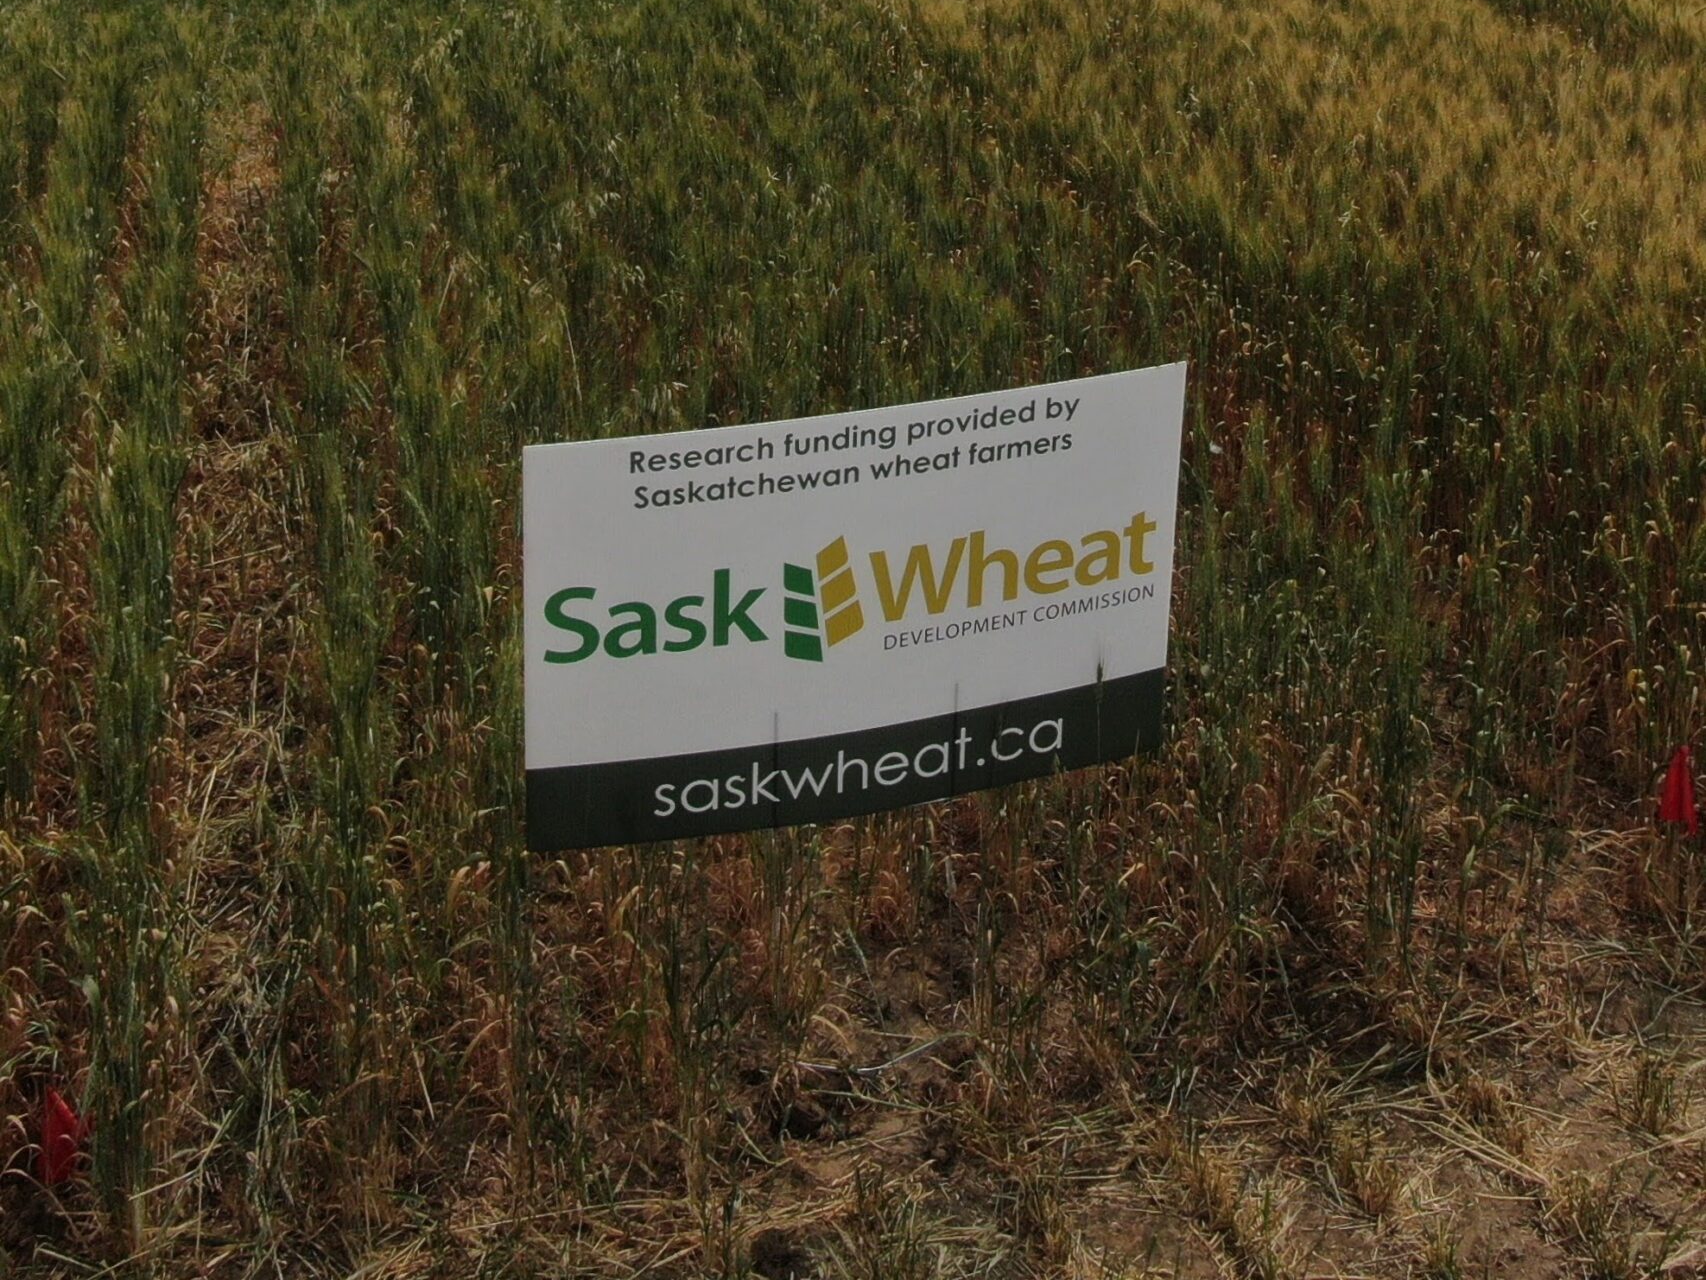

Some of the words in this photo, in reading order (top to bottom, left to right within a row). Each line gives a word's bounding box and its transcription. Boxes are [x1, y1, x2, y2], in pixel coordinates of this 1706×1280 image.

[629, 437, 775, 474] Research
[783, 423, 897, 457] funding
[907, 399, 1036, 446] provided
[1045, 397, 1081, 422] by
[633, 466, 860, 510] Saskatchewan
[869, 446, 961, 480] wheat
[968, 433, 1073, 466] farmers
[543, 568, 769, 664] Sask
[869, 512, 1157, 622] Wheat
[883, 610, 1028, 651] DEVELOPMENT
[1033, 583, 1154, 623] COMMISSION
[654, 718, 1063, 817] saskwheat.ca
